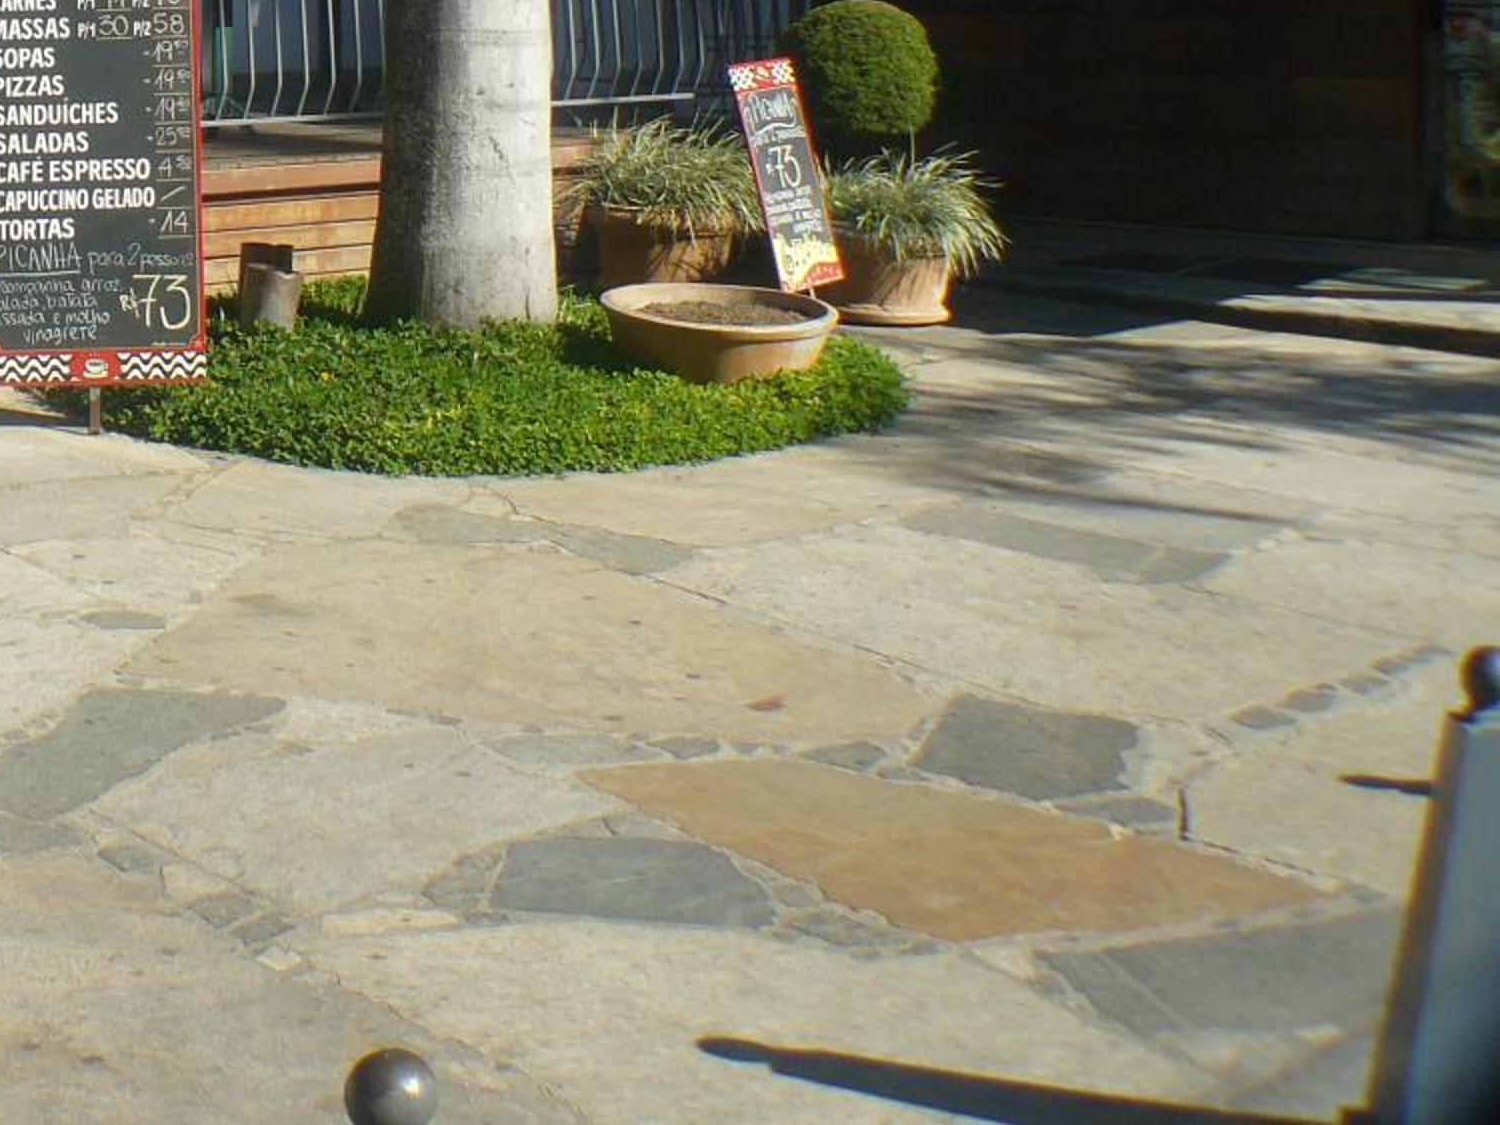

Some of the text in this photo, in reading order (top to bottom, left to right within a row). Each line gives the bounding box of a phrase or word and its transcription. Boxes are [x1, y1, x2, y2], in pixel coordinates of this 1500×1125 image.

[98, 14, 129, 37] 30
[153, 12, 185, 35] 58
[49, 157, 151, 183] ESPRESSO
[767, 144, 802, 189] 73
[92, 186, 156, 210] GELADO
[160, 210, 189, 233] 14
[87, 250, 125, 276] para
[127, 242, 141, 266] 2
[132, 274, 191, 330] 73
